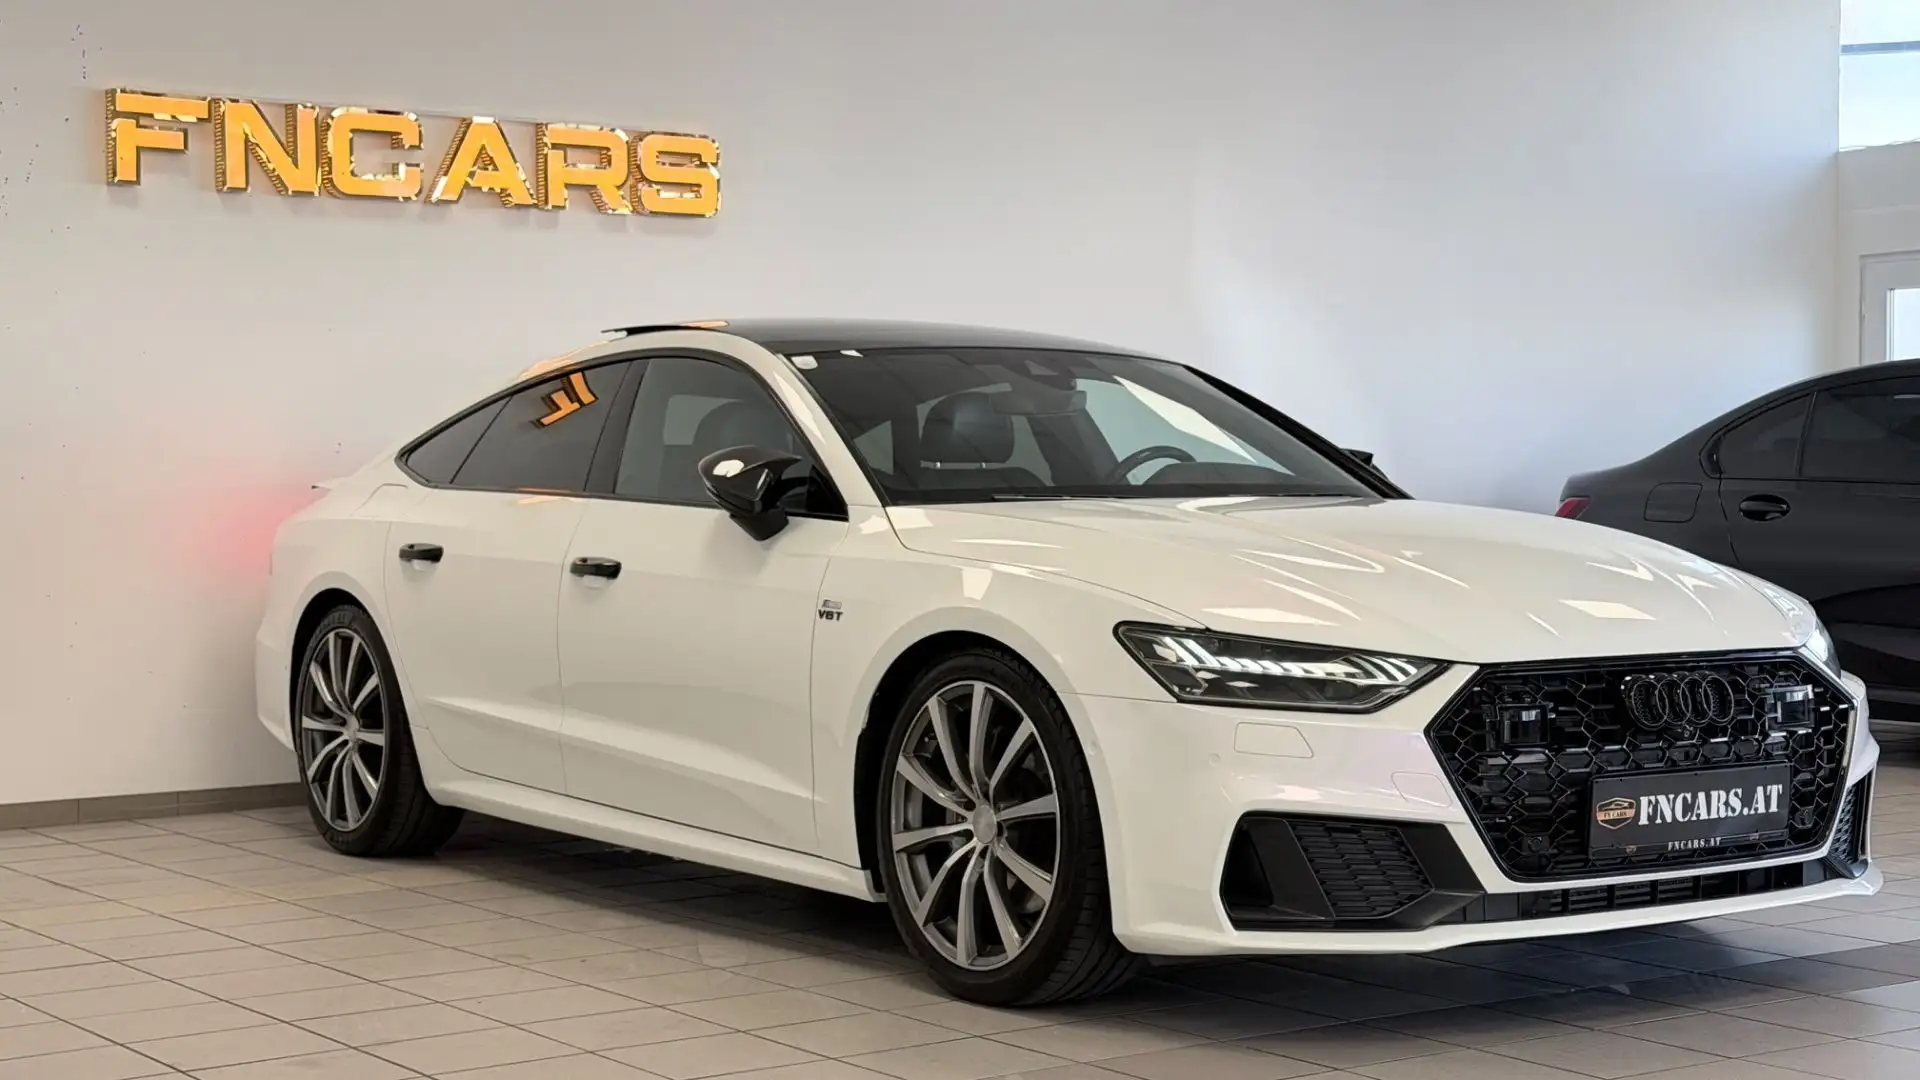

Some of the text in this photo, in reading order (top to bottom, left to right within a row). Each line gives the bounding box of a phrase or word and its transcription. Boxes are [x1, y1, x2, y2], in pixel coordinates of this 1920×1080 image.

[104, 87, 721, 219] FNCARS
[1638, 784, 1783, 825] FNCARS.AT
[1667, 836, 1722, 851] FNCARS.AT
